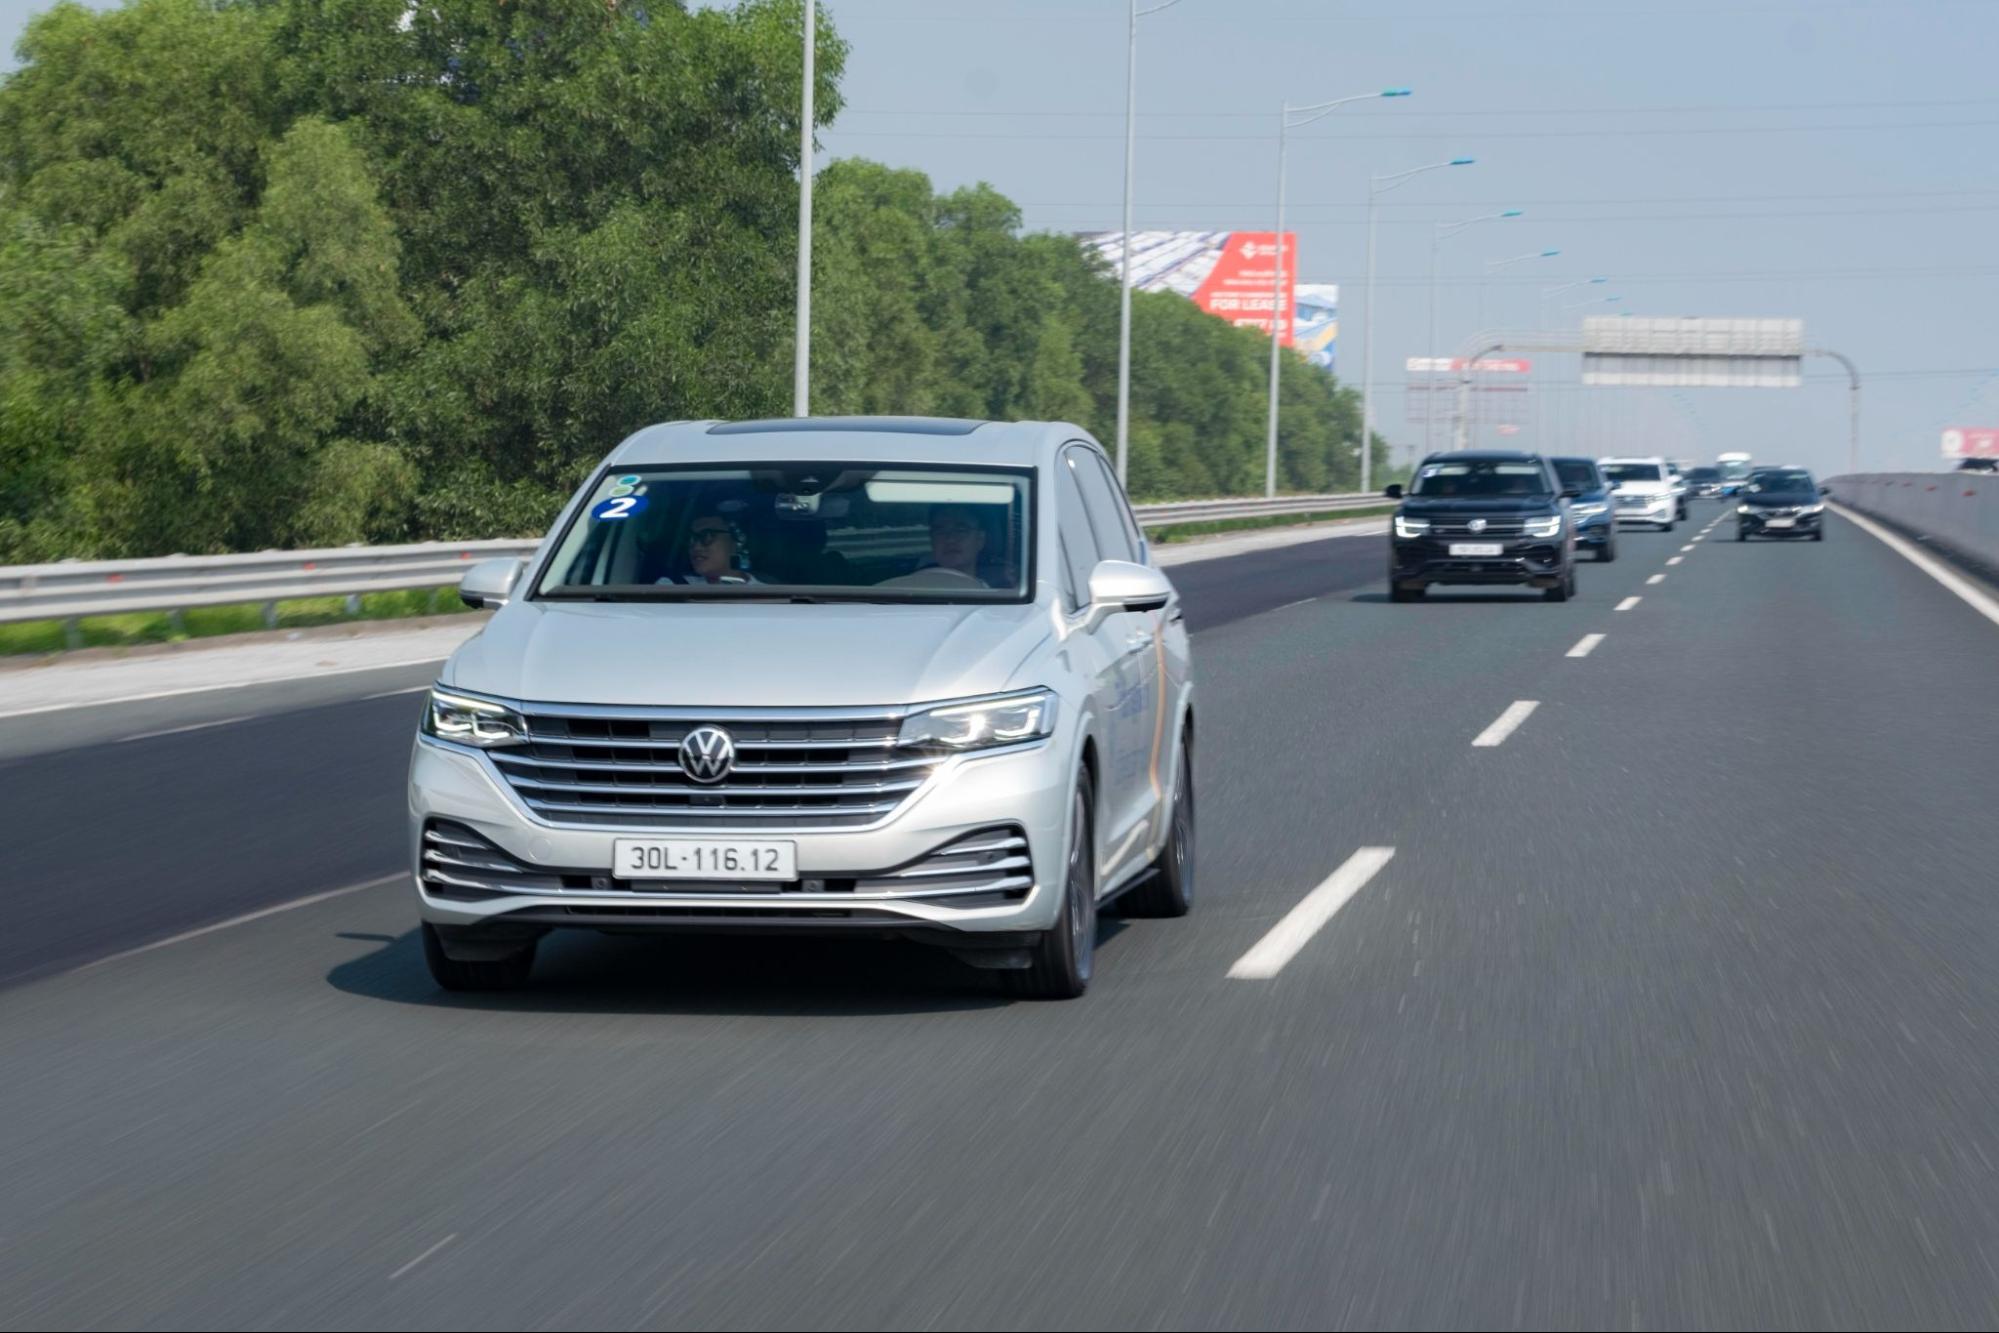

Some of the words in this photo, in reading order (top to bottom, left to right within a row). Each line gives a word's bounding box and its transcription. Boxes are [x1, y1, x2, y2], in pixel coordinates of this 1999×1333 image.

[1210, 299, 1238, 310] FOR
[599, 497, 637, 518] 2
[681, 728, 734, 780] VW
[631, 846, 779, 871] 30L-116.12
